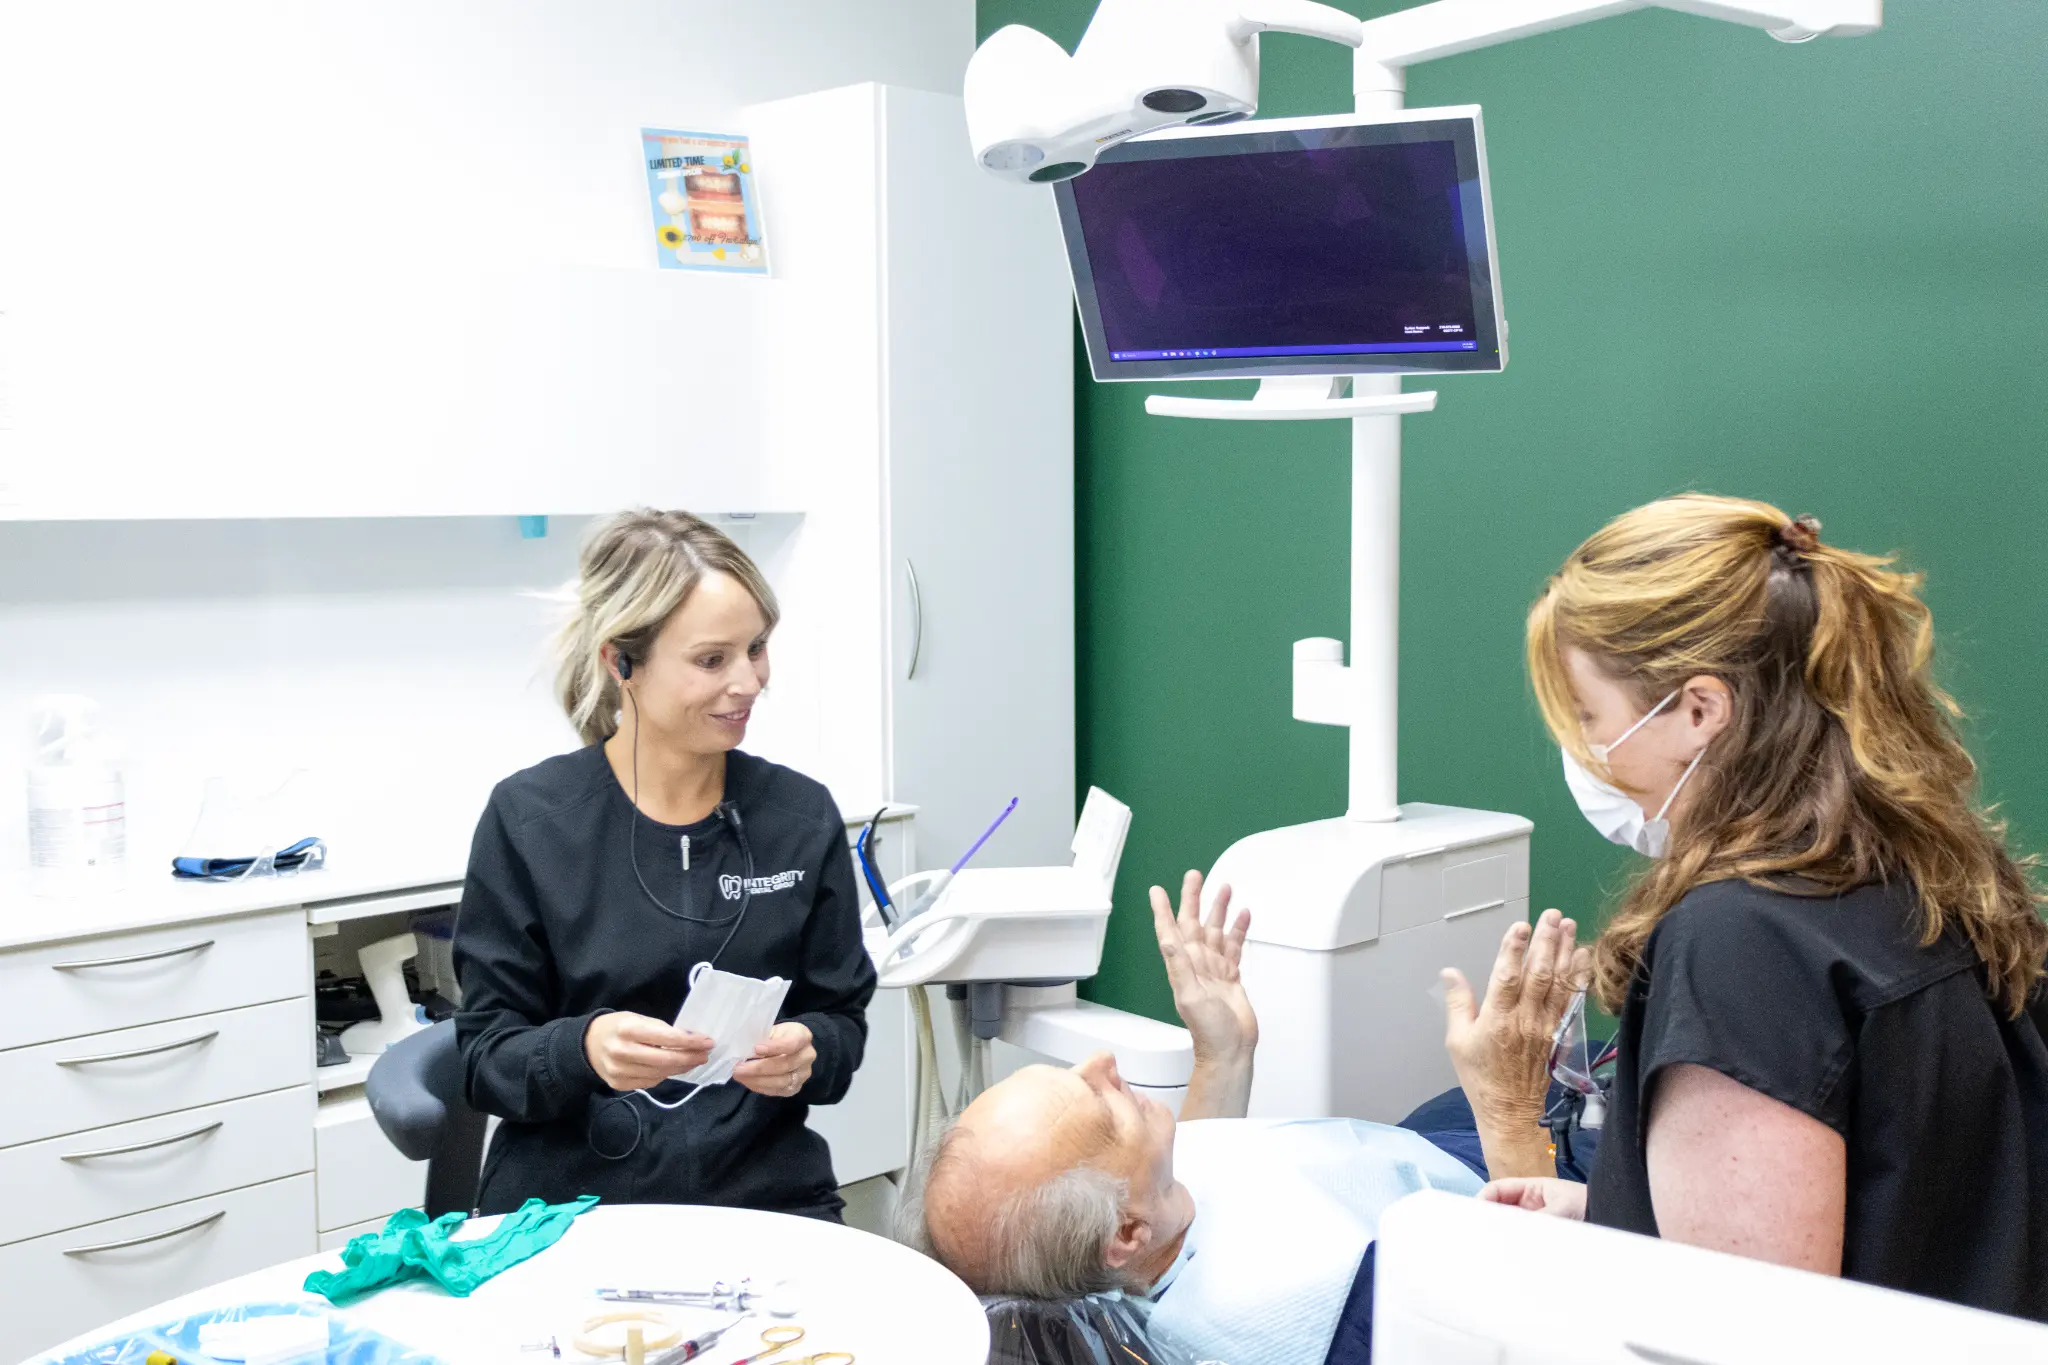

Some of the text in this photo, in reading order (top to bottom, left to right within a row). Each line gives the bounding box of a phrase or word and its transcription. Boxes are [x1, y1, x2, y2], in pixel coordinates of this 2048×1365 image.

[649, 155, 705, 170] LIMITED TIME
[743, 870, 805, 888] INTEGRITY
